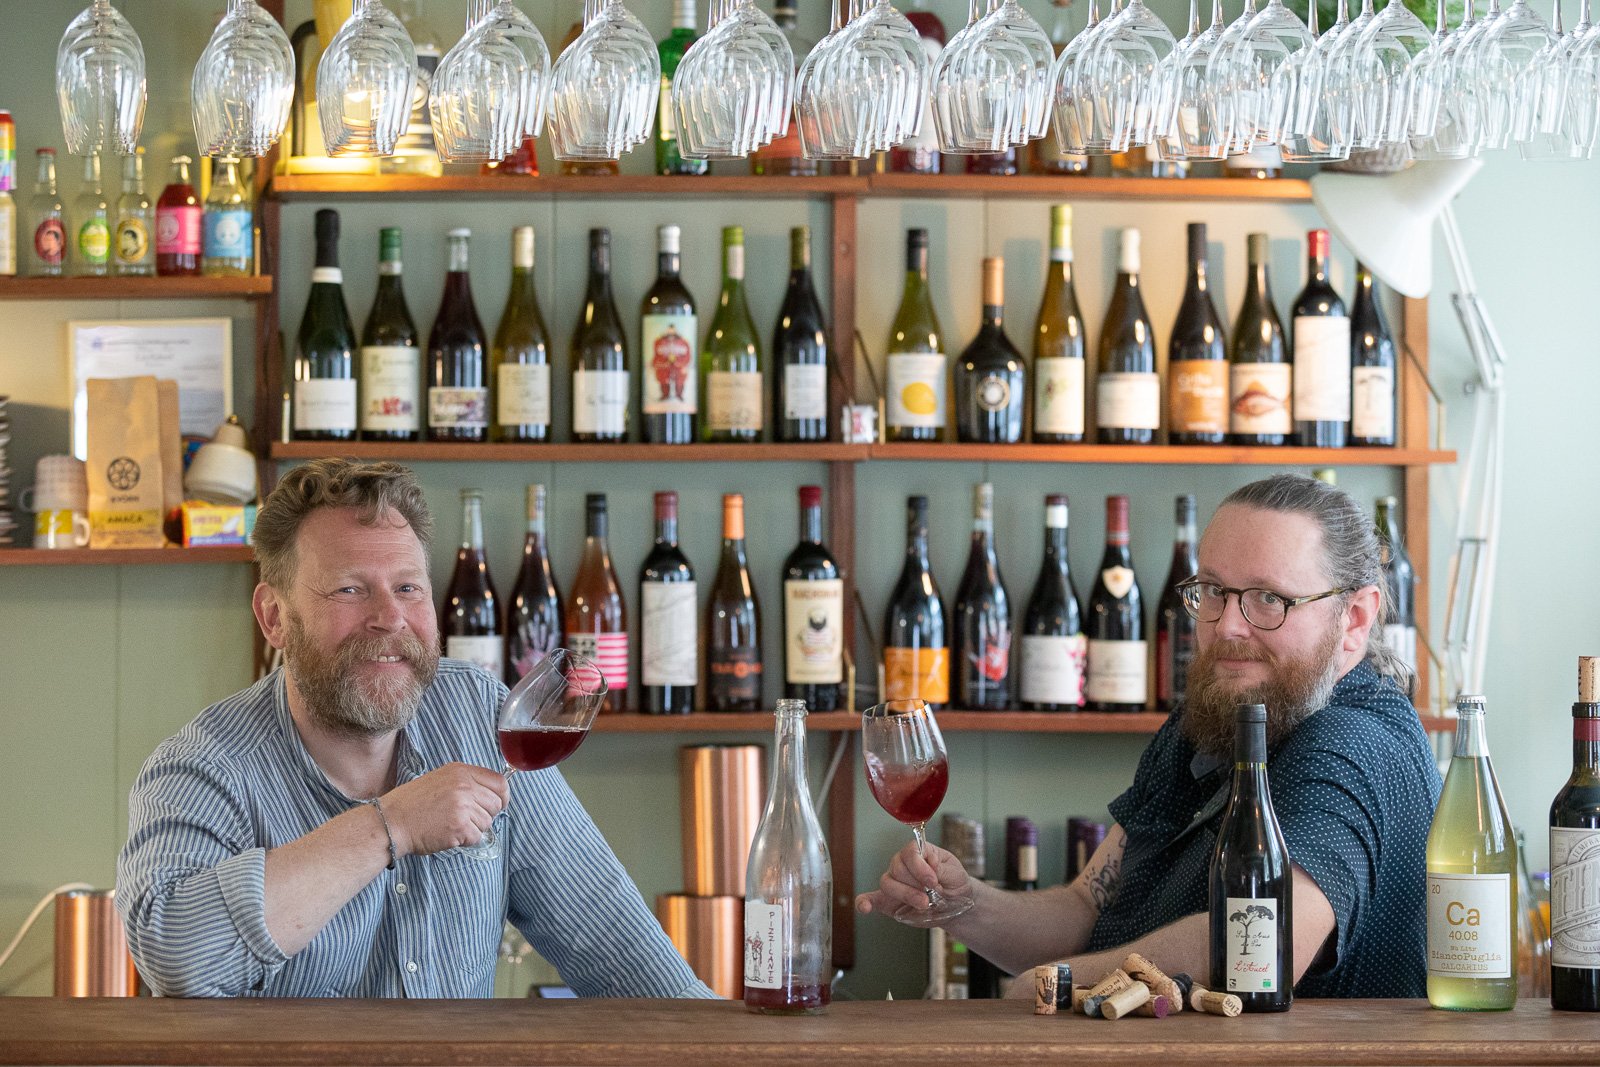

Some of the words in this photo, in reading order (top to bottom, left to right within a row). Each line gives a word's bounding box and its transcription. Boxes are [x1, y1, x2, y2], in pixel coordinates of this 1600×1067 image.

[1431, 884, 1441, 895] 20
[1446, 901, 1480, 926] Ca
[767, 911, 776, 984] PIZZICANTE
[1431, 951, 1502, 962] BiancoPuglia
[1440, 963, 1489, 971] CALCARIUS
[1225, 998, 1240, 1014] 2017
